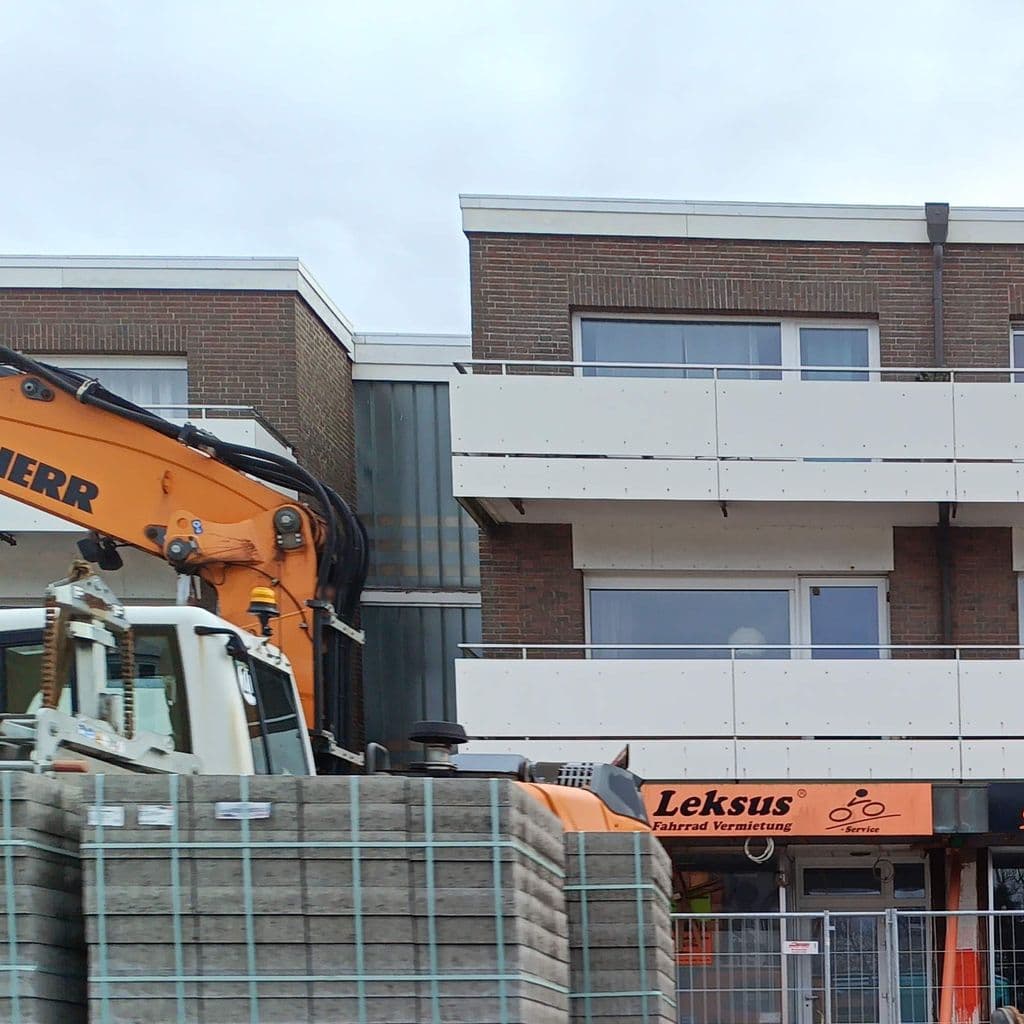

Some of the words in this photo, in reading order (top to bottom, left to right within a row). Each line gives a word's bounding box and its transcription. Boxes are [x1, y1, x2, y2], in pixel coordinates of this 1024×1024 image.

[652, 789, 794, 817] Leksus
[651, 821, 709, 832] Fahrrad
[713, 821, 793, 833] Vermietung
